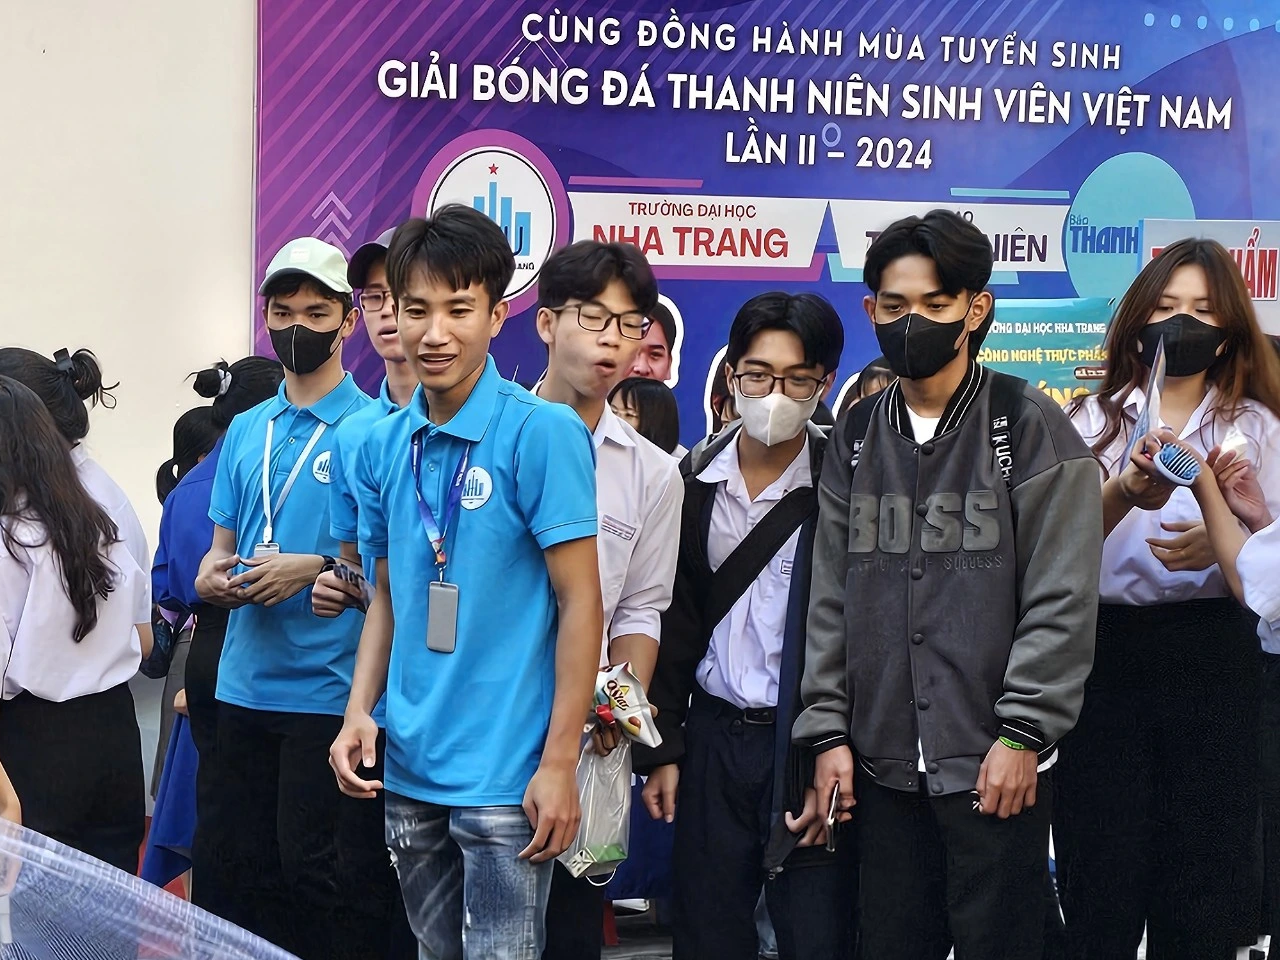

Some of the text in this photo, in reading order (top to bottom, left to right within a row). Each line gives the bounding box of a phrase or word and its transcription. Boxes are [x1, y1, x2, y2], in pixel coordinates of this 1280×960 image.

[522, 8, 1121, 70] CÙNG ĐỒNG HÀNH MÙA TUYỂN SINH
[377, 51, 1232, 135] GIẢI BÓNG ĐÁ THANH NIÊN SINH VIÊN VIỆT NAM
[725, 116, 787, 165] LẦN
[855, 136, 933, 170] 2024
[628, 198, 694, 218] TRƯỜNG
[724, 204, 757, 221] HỌC
[672, 227, 789, 258] TRANG
[848, 490, 1001, 553] BOSS
